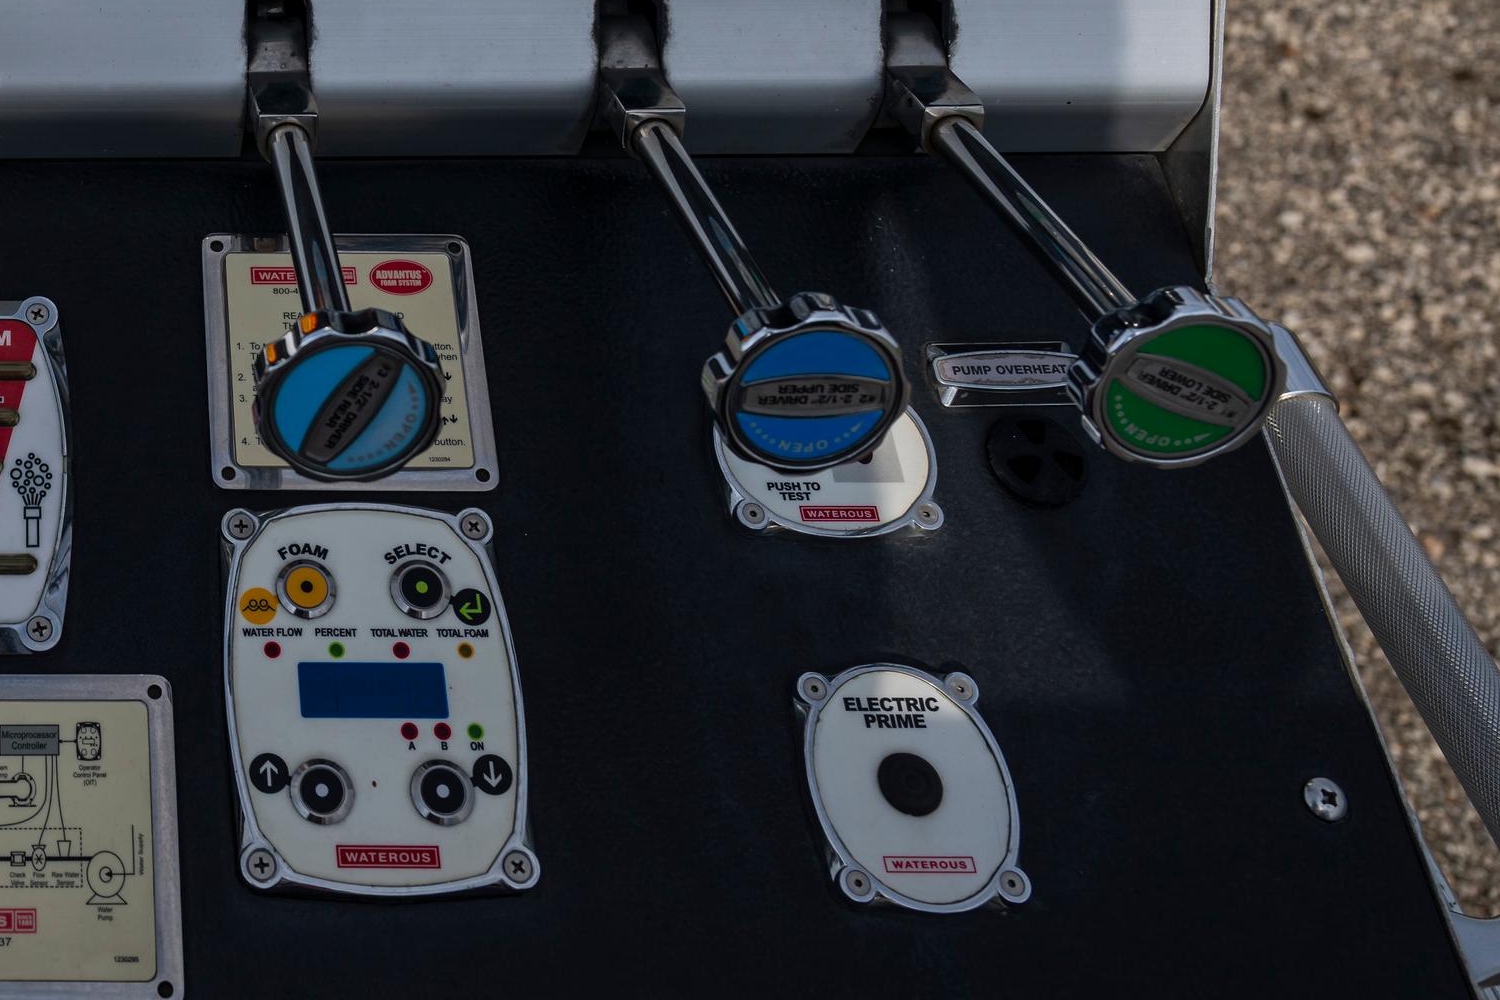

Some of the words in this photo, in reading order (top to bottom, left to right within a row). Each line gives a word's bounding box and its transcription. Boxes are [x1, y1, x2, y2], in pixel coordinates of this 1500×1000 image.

[952, 365, 992, 376] PUMP
[995, 364, 1067, 376] OVERHEAT
[766, 482, 800, 491] PUSH
[802, 482, 821, 491] TO
[780, 492, 811, 501] TEST
[806, 510, 872, 518] WATEROUS
[277, 543, 329, 560] FOAM
[384, 543, 452, 565] SELECT
[242, 628, 275, 637] WATER
[278, 628, 303, 637] FLOW
[314, 628, 356, 638] PERCENT
[370, 628, 398, 638] TOTAL
[398, 628, 428, 638] WATER
[436, 628, 463, 638] TOTAL
[464, 628, 489, 638] FOAM
[842, 697, 940, 712] ELECTRIC
[864, 714, 927, 728] PRIME
[2, 731, 58, 740] Microprocessor
[12, 742, 47, 750] Controller
[408, 742, 416, 750] A
[441, 742, 448, 750] B
[470, 742, 484, 750] ON
[344, 852, 432, 863] WATEROUS
[892, 860, 968, 870] WATEROUS
